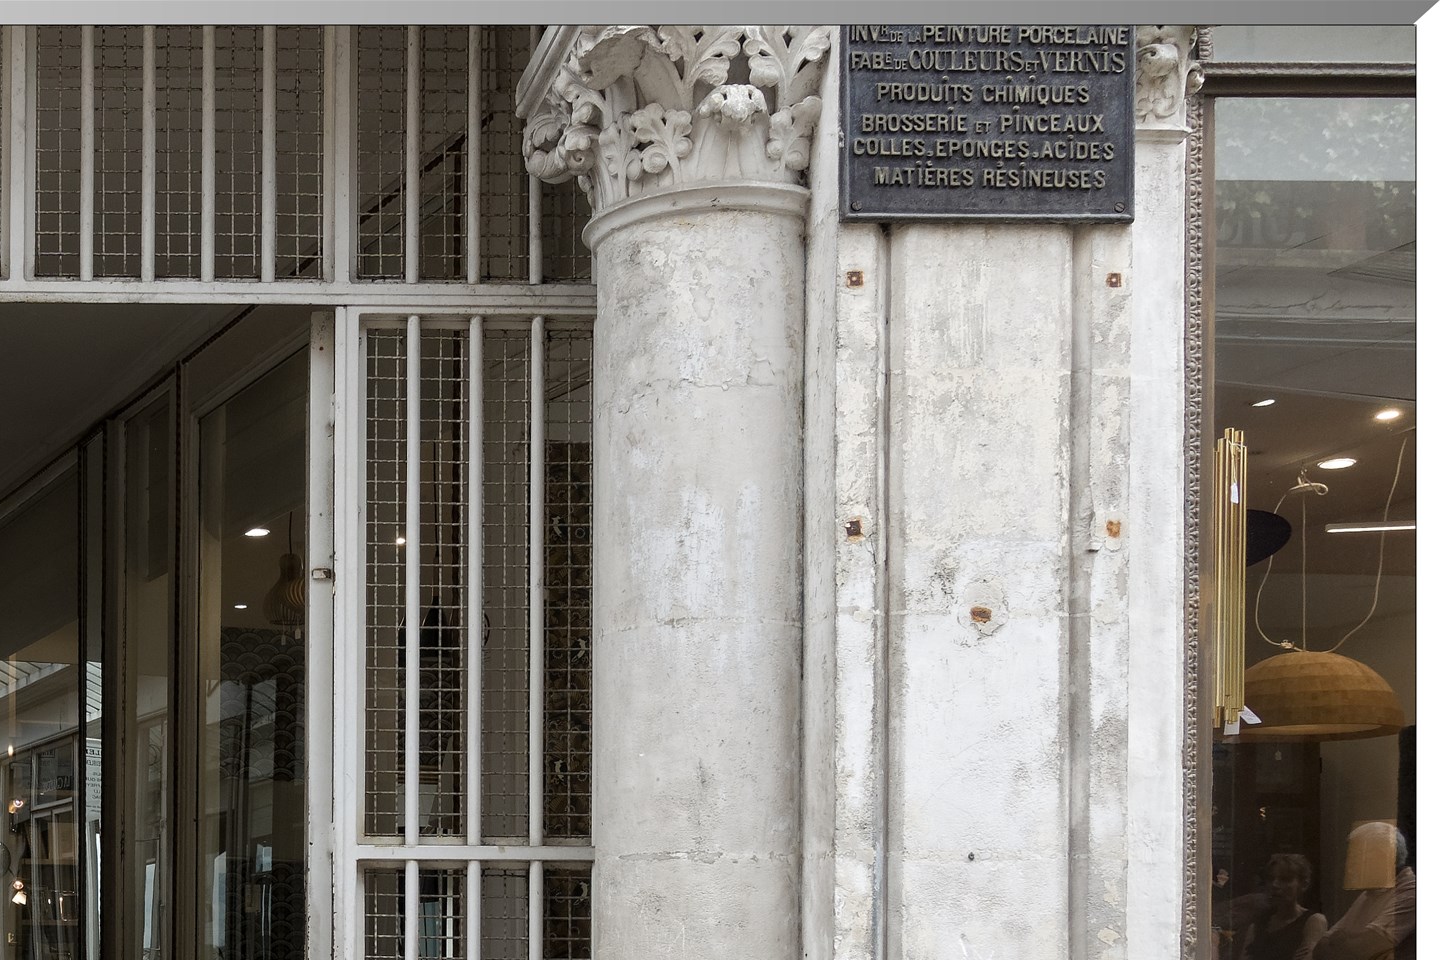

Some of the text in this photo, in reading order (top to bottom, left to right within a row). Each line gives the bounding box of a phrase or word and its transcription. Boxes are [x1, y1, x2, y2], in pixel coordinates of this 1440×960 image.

[890, 31, 903, 42] DE
[922, 25, 1010, 43] PEINTURE
[1017, 25, 1129, 45] PORCELAINE
[893, 58, 908, 70] DE
[908, 49, 1025, 72] COULEURS
[1025, 59, 1039, 71] ET
[1038, 45, 1126, 73] VERNIS
[876, 75, 1090, 104] PRODUITS CHIMIQUES
[862, 106, 1105, 133] BROSSERIE ET PINCEAUX
[1041, 134, 1115, 160] ACIDES
